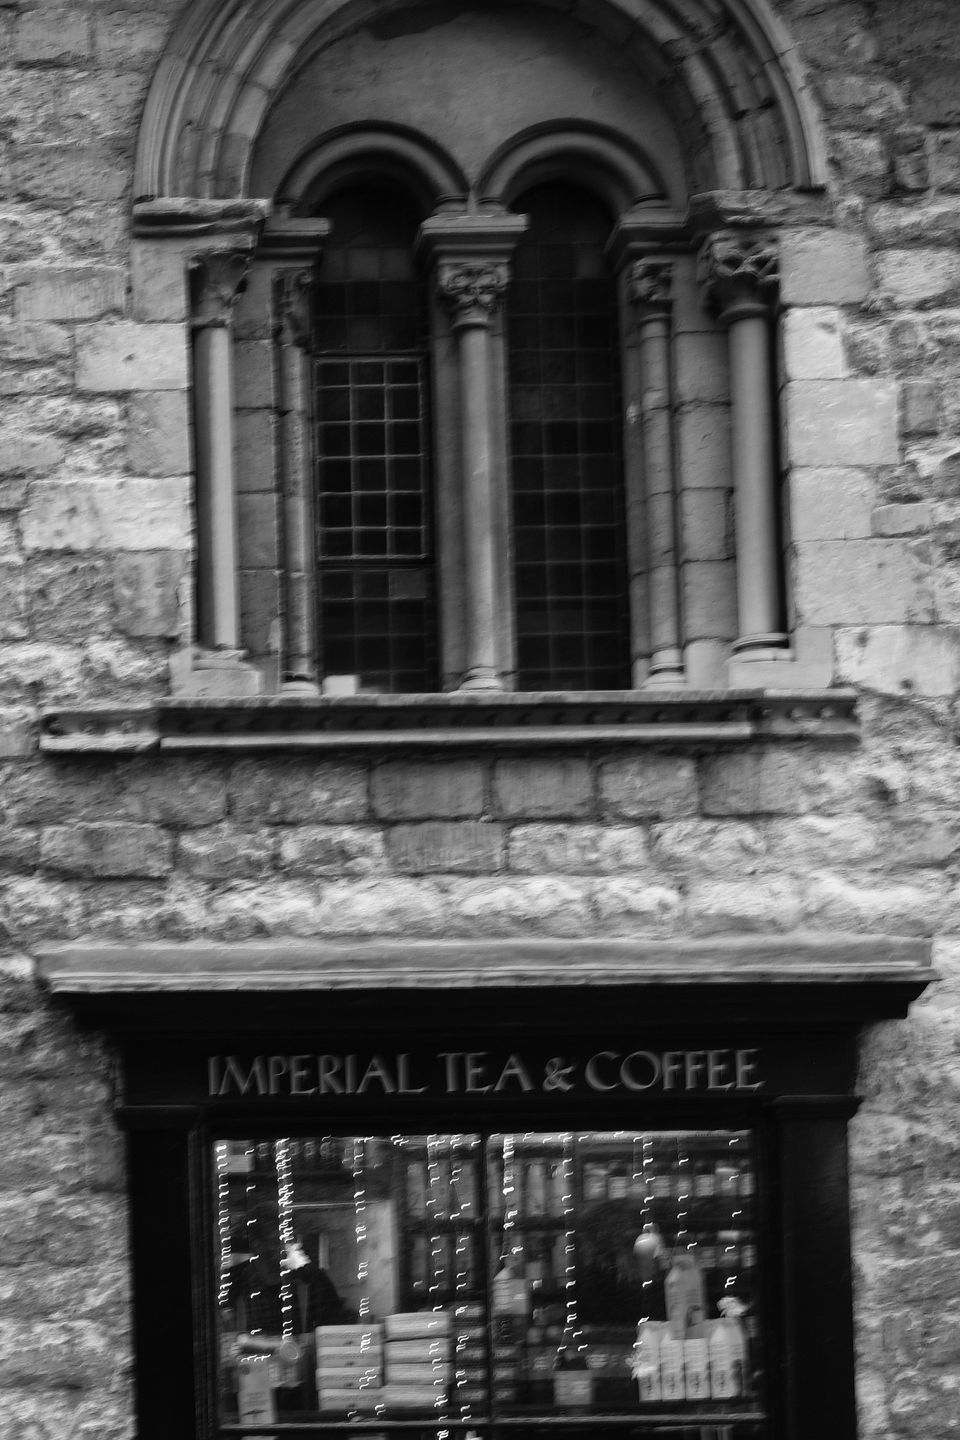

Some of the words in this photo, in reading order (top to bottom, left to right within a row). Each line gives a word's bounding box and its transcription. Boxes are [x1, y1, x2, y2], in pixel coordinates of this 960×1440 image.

[207, 1053, 430, 1096] IMPERIAL
[437, 1051, 537, 1094] TEA
[542, 1056, 576, 1092] &
[584, 1049, 768, 1092] COFFEE
